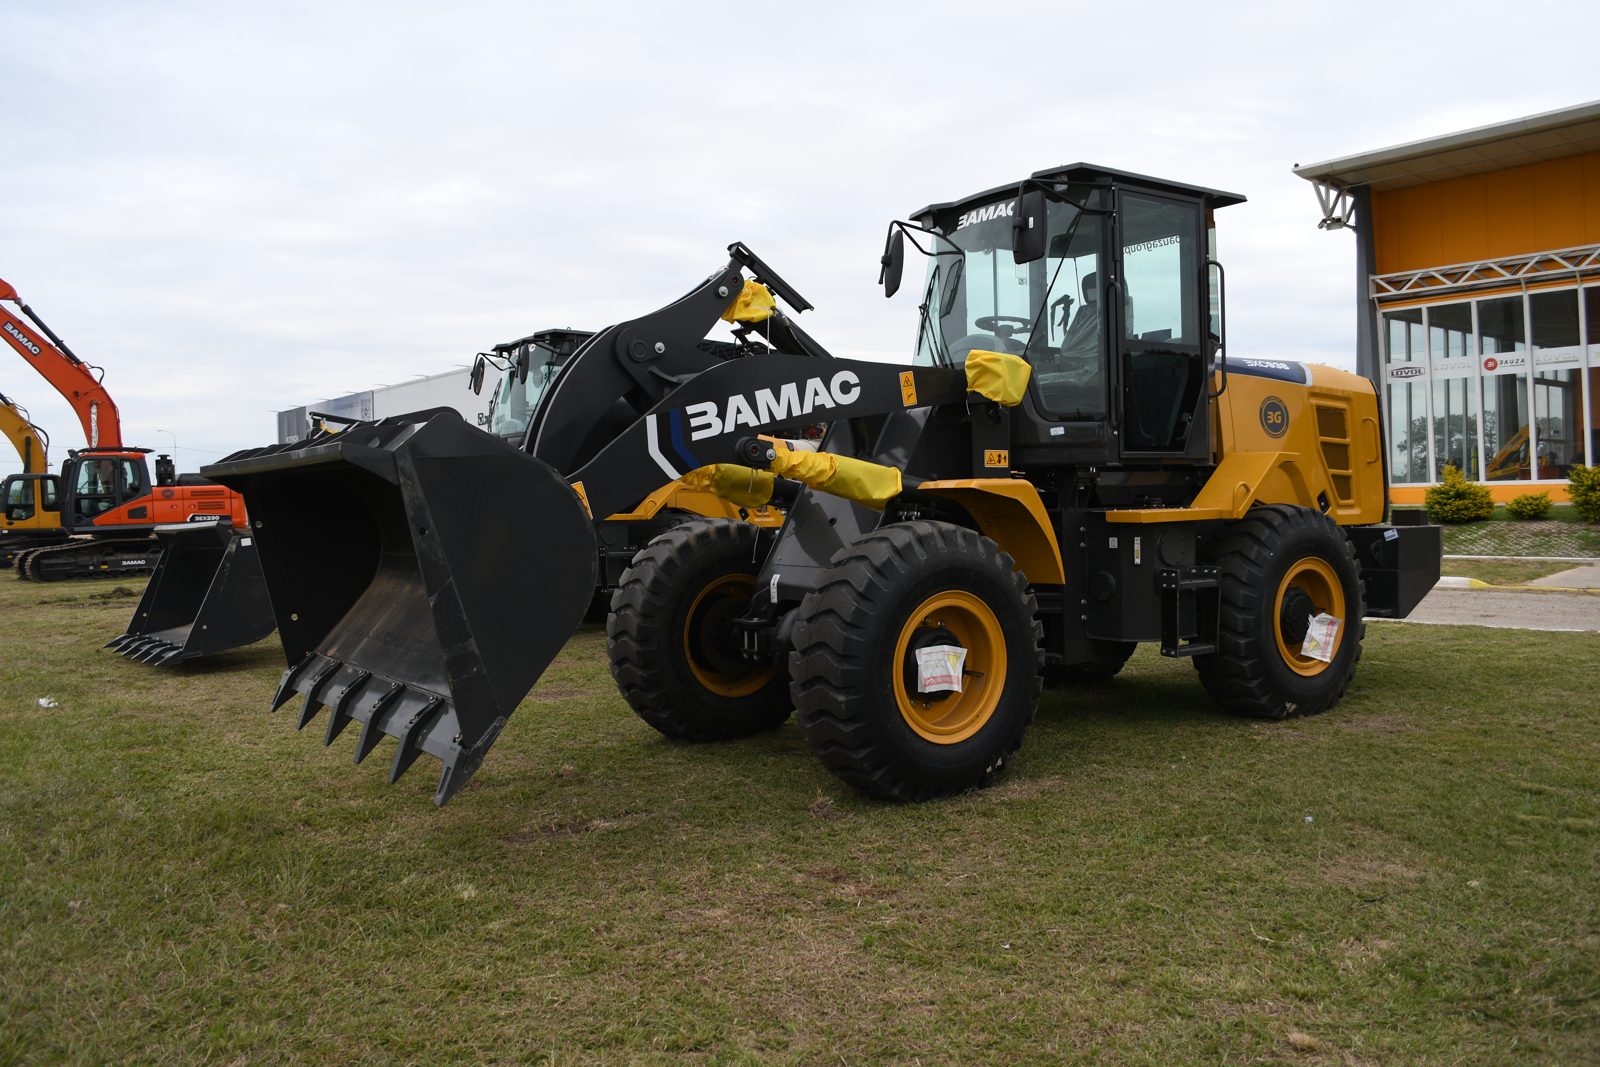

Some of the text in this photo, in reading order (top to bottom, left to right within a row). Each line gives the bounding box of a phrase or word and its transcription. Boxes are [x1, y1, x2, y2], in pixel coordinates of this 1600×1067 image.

[957, 201, 1016, 230] BAMAC
[3, 322, 40, 355] BAMAC
[1390, 367, 1424, 377] LOVOL
[1499, 358, 1525, 366] BAUZA
[685, 370, 861, 441] BAMAC
